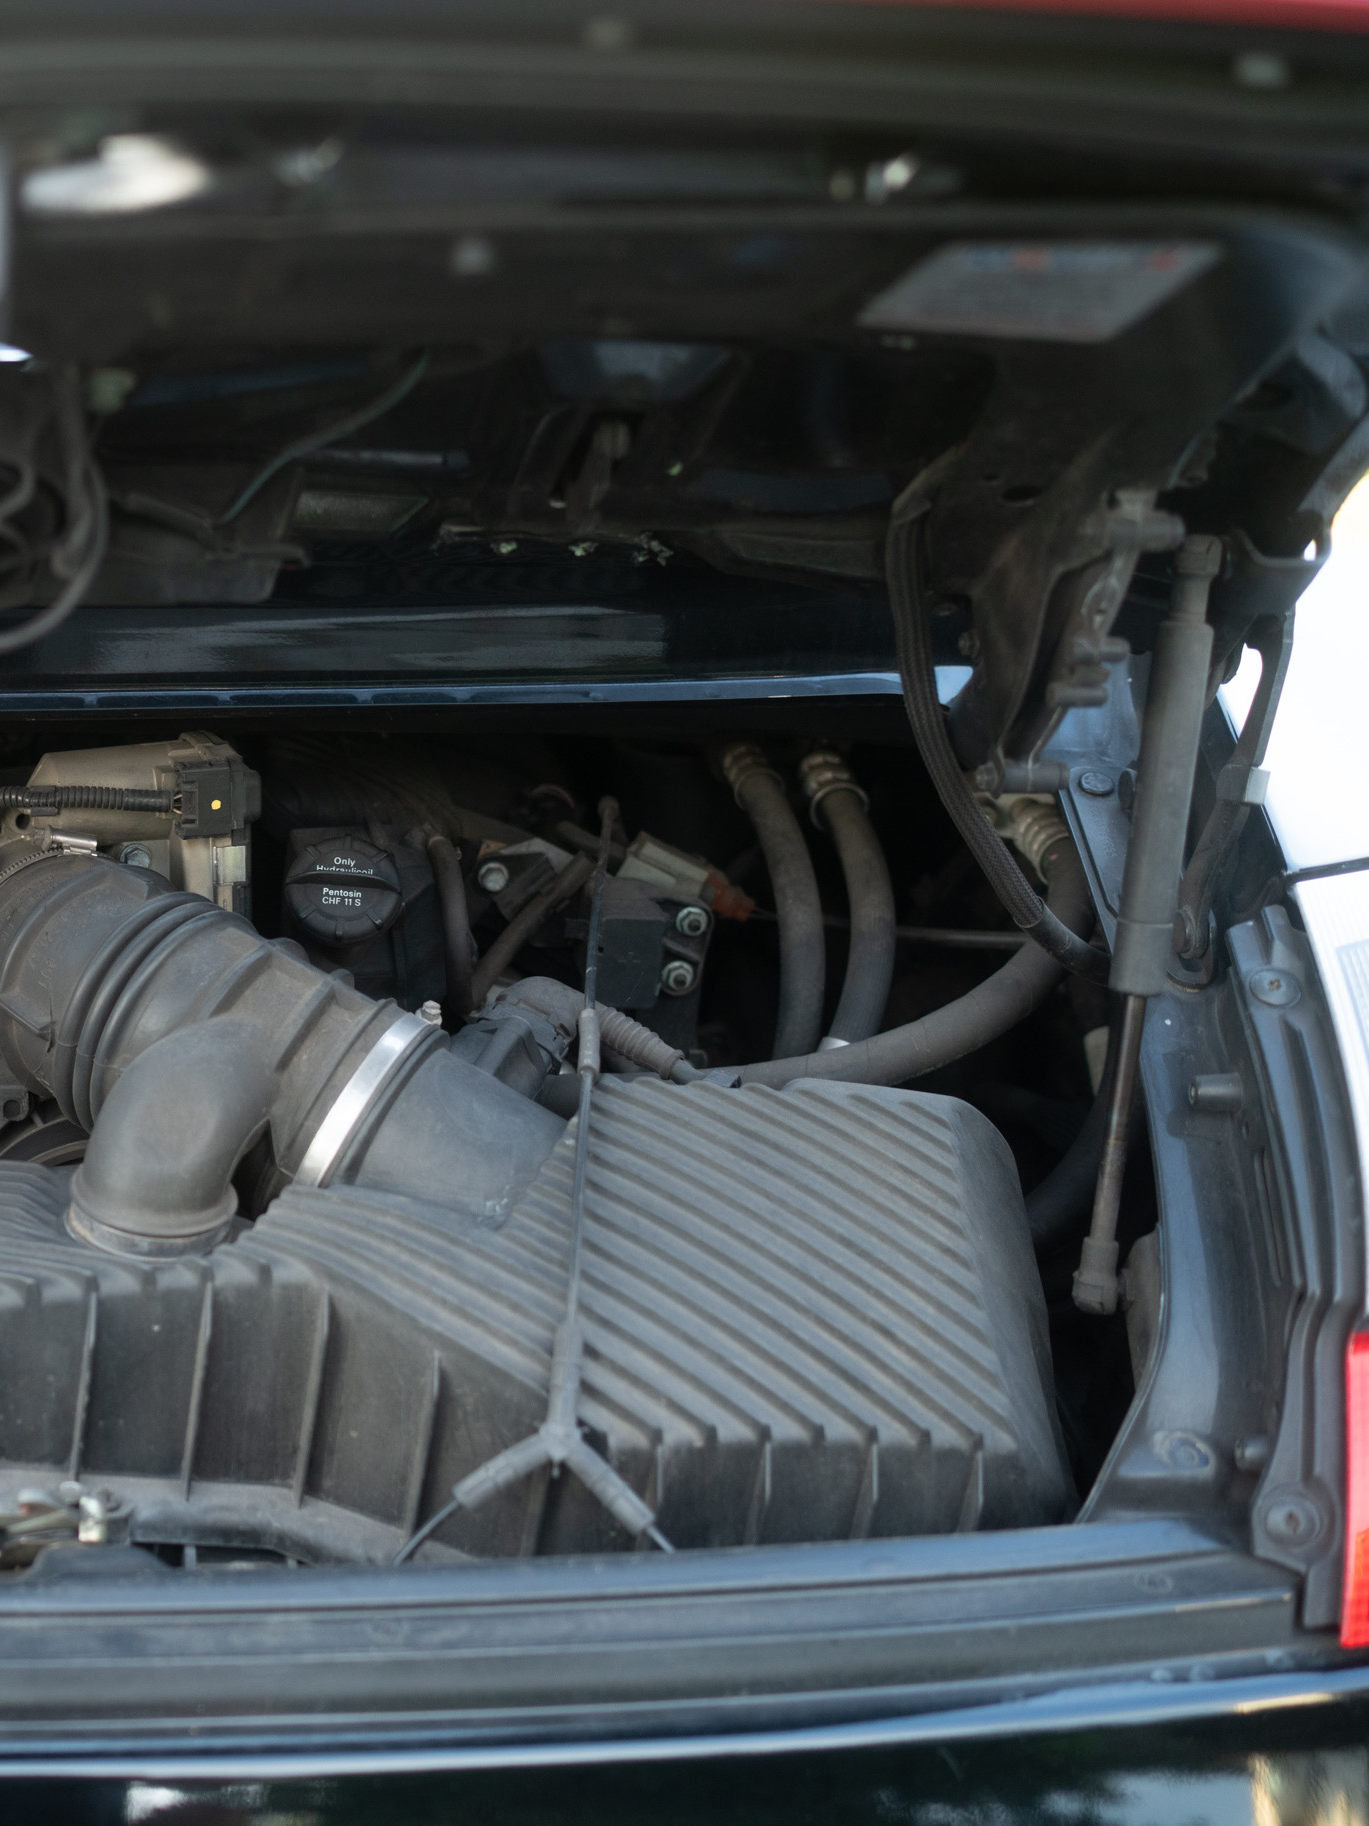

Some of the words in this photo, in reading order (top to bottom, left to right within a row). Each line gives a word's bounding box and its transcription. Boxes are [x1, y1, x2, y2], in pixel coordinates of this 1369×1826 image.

[333, 856, 356, 867] Only
[322, 887, 362, 898] Pentosin
[322, 896, 341, 905] CHF
[344, 897, 353, 906] 11
[354, 898, 362, 907] S
